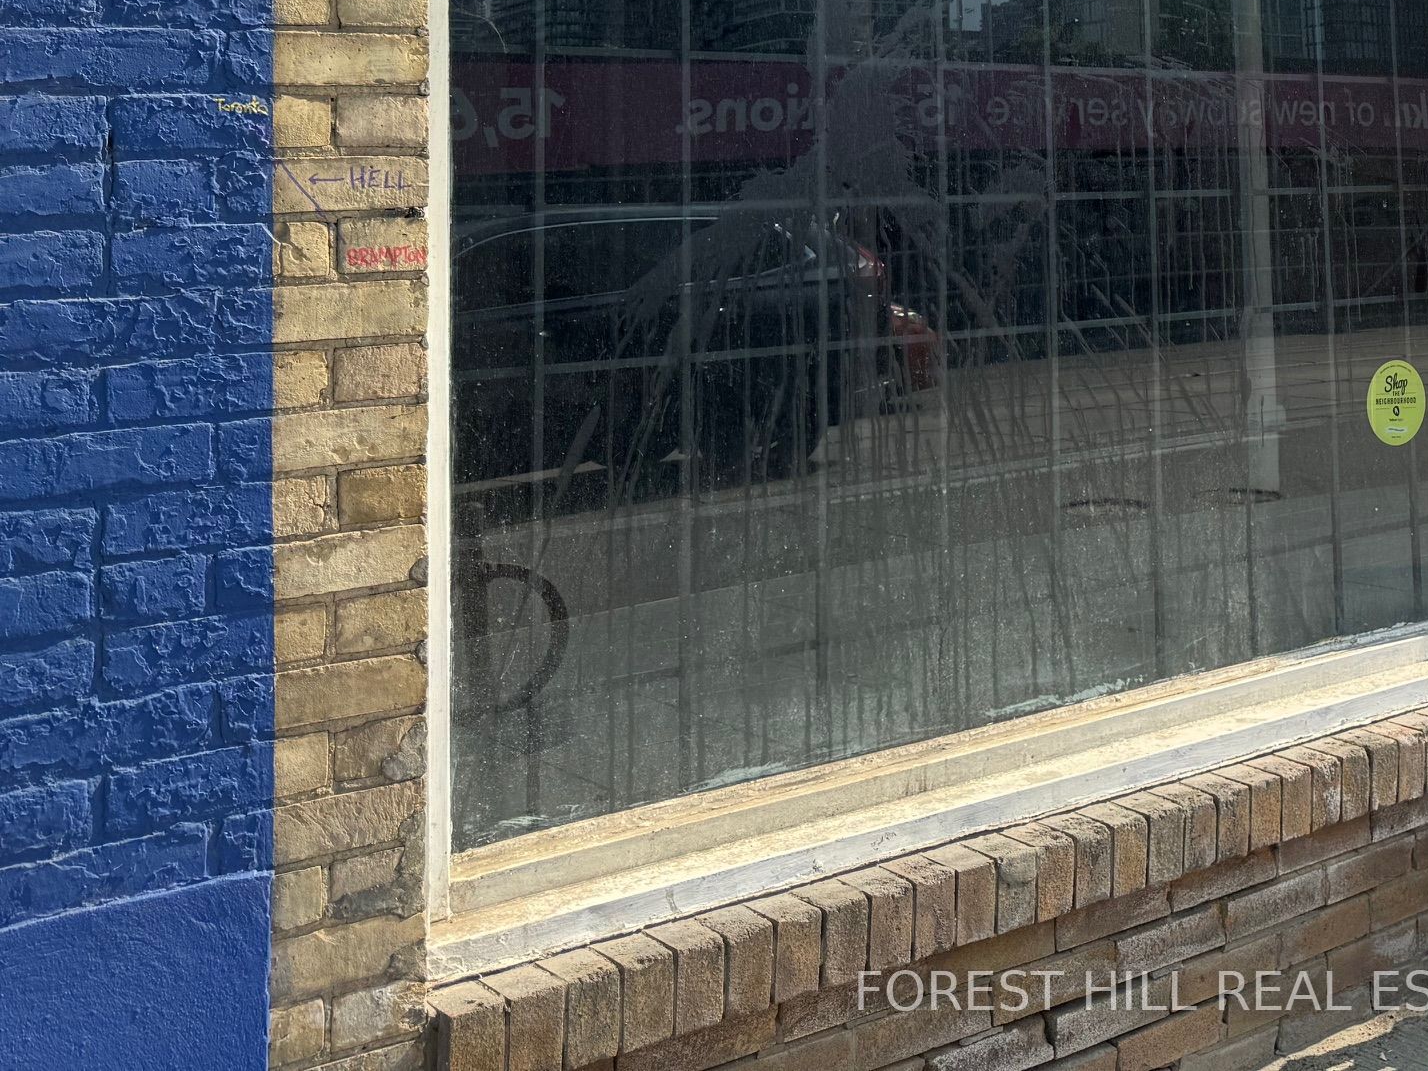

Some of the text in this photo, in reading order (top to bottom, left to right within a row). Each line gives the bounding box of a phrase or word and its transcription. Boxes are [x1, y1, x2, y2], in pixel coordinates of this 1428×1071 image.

[214, 96, 269, 115] Toronto
[349, 165, 411, 190] HELL
[347, 245, 428, 267] BRAMPTON
[1384, 372, 1408, 396] Shop
[1375, 397, 1417, 405] NEIGHBOURHOOD
